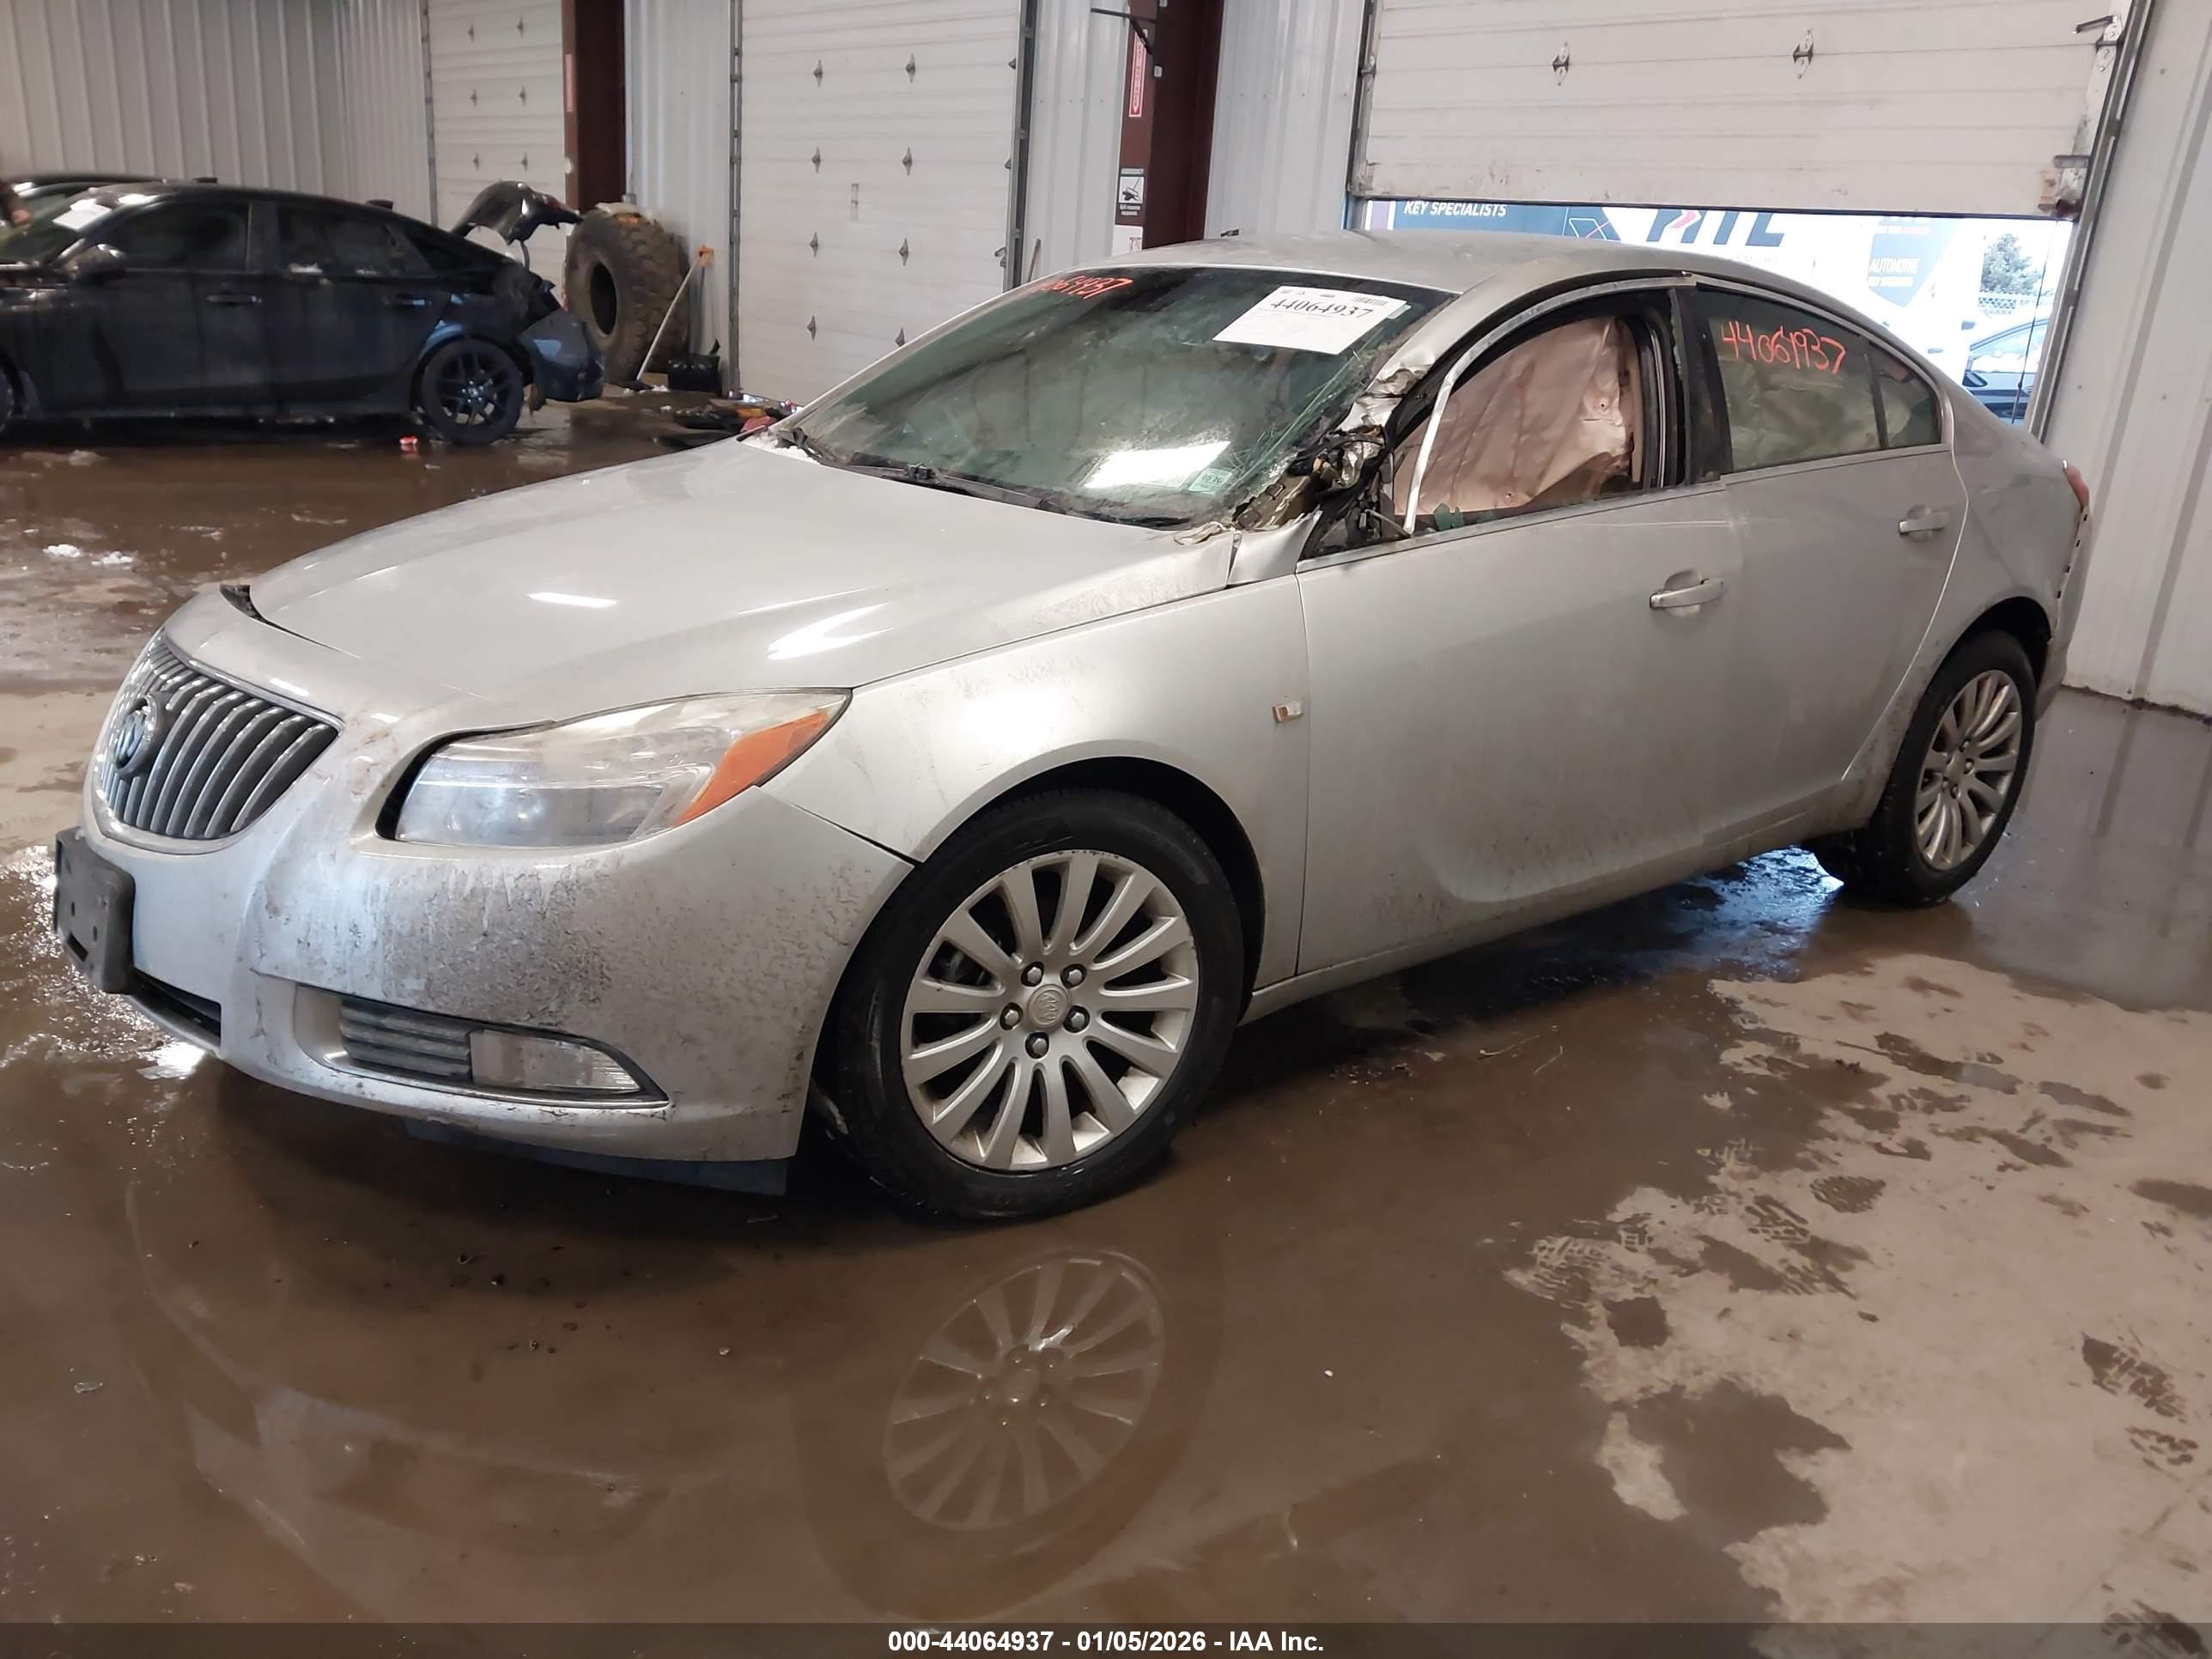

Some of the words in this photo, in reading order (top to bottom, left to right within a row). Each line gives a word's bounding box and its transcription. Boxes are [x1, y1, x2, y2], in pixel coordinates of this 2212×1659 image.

[1403, 200, 1429, 215] KEY
[1430, 202, 1508, 217] SPECIALISTS
[1270, 298, 1375, 319] 44064937
